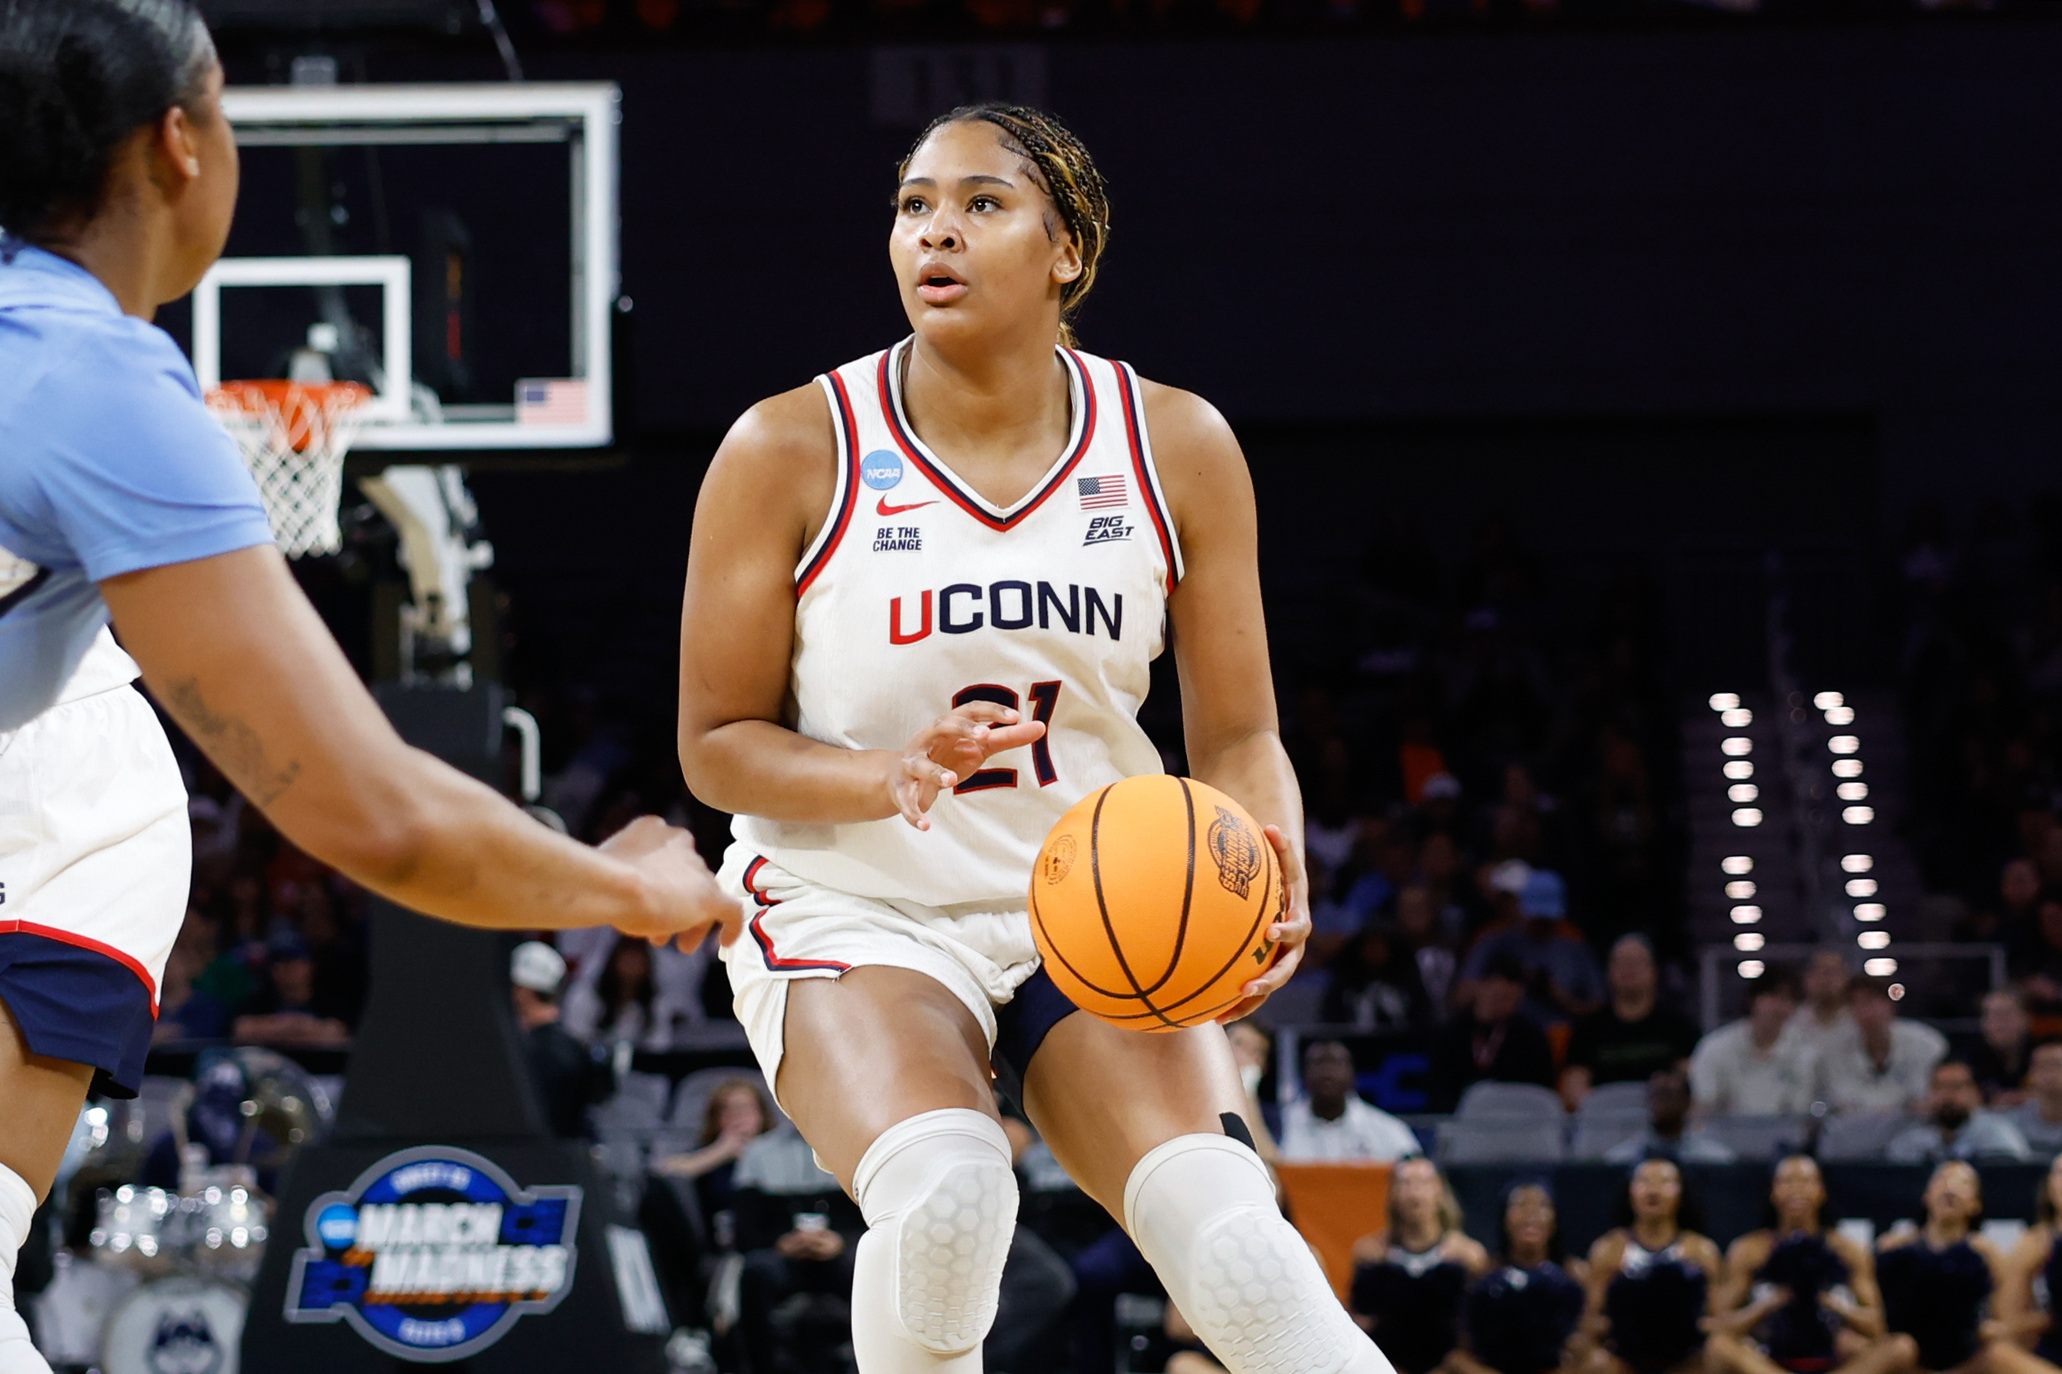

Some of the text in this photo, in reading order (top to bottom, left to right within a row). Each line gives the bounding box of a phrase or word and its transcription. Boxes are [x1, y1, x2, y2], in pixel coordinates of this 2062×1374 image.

[866, 468, 900, 479] NCAA
[1089, 515, 1124, 529] BIG
[877, 527, 920, 539] BE THE
[1085, 526, 1135, 540] EAST
[873, 539, 922, 552] CHANGE
[890, 580, 1122, 645] UCONN
